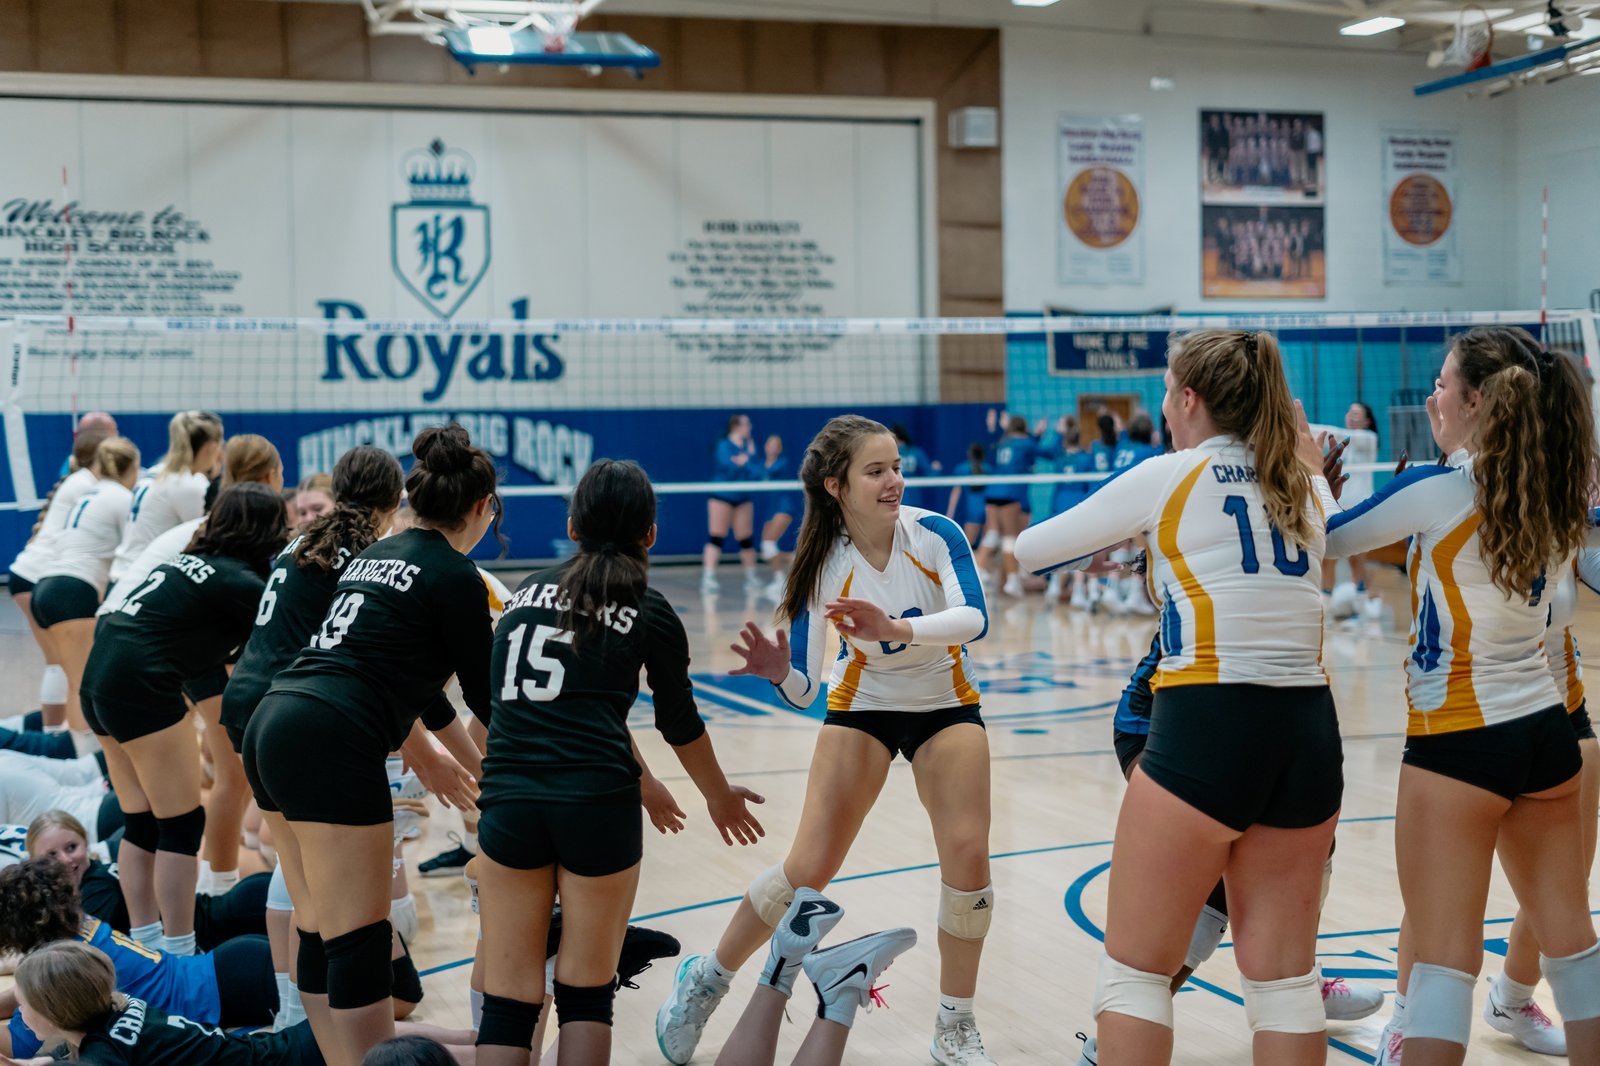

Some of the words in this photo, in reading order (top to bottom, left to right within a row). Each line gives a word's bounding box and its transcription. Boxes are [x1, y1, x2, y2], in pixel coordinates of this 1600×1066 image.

[3, 199, 142, 223] Welcome
[152, 204, 184, 225] to
[316, 297, 567, 403] Royals
[513, 416, 594, 486] ROCK
[1212, 464, 1260, 483] CHAR
[254, 568, 287, 626] 6
[337, 558, 422, 592] HARGERS
[501, 623, 575, 702] 15
